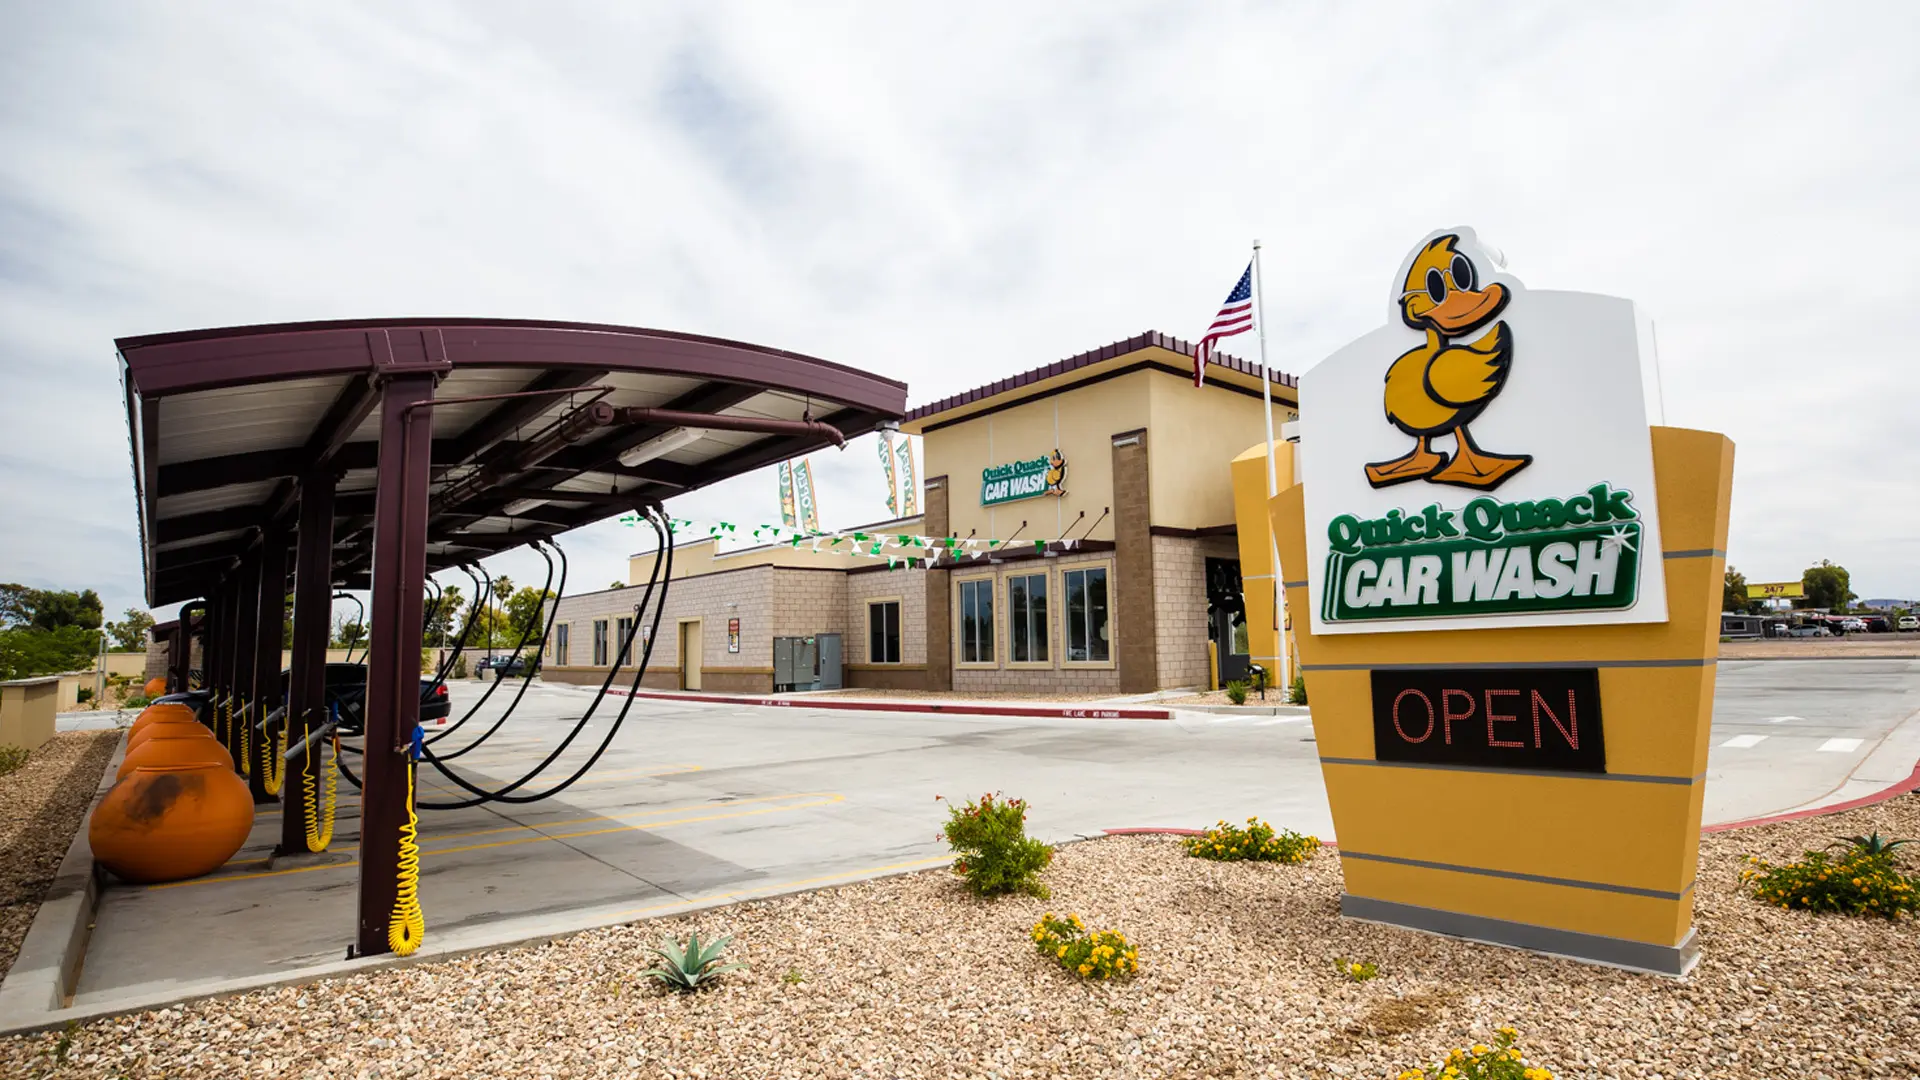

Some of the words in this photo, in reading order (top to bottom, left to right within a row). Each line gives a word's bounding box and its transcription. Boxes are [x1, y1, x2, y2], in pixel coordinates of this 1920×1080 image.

[983, 464, 1013, 481] Quick
[1014, 455, 1049, 473] Quack
[985, 481, 1009, 501] CAR
[1010, 473, 1046, 497] WASH
[1328, 502, 1460, 554] Quick
[1463, 482, 1637, 542] Quack
[1344, 555, 1443, 609] CAR
[1451, 539, 1624, 603] WASH
[1764, 585, 1785, 593] 24/7
[1392, 688, 1580, 750] OPEN
